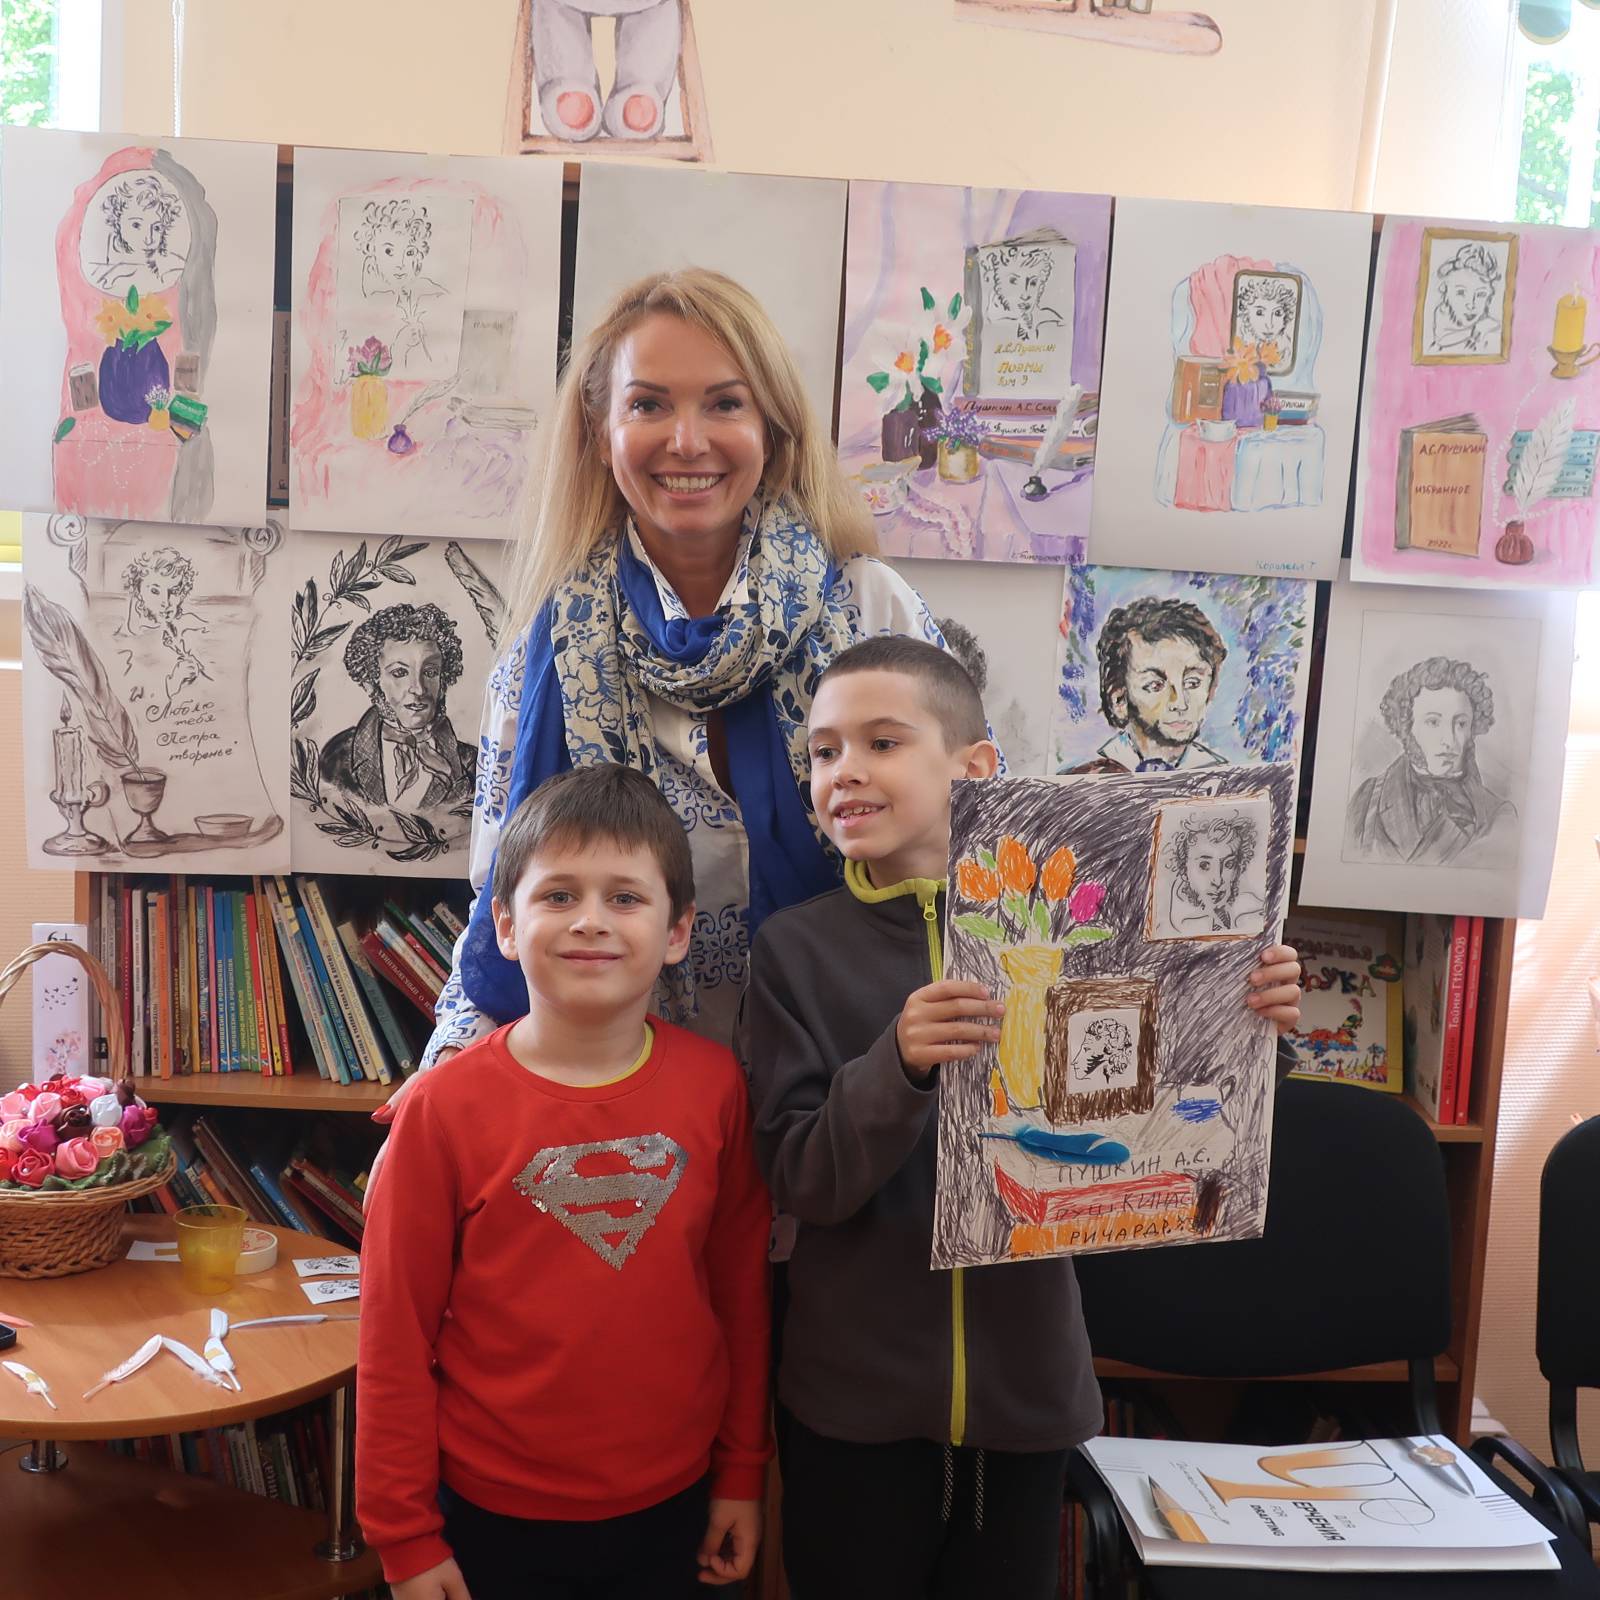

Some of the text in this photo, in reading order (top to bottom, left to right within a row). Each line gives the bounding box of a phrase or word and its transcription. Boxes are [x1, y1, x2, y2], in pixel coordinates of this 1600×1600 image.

[146, 699, 215, 722] Люблю
[175, 713, 216, 726] тебя
[157, 732, 220, 748] Петра
[1449, 992, 1461, 1030] Тайны
[1250, 1504, 1285, 1537] DRAFTING
